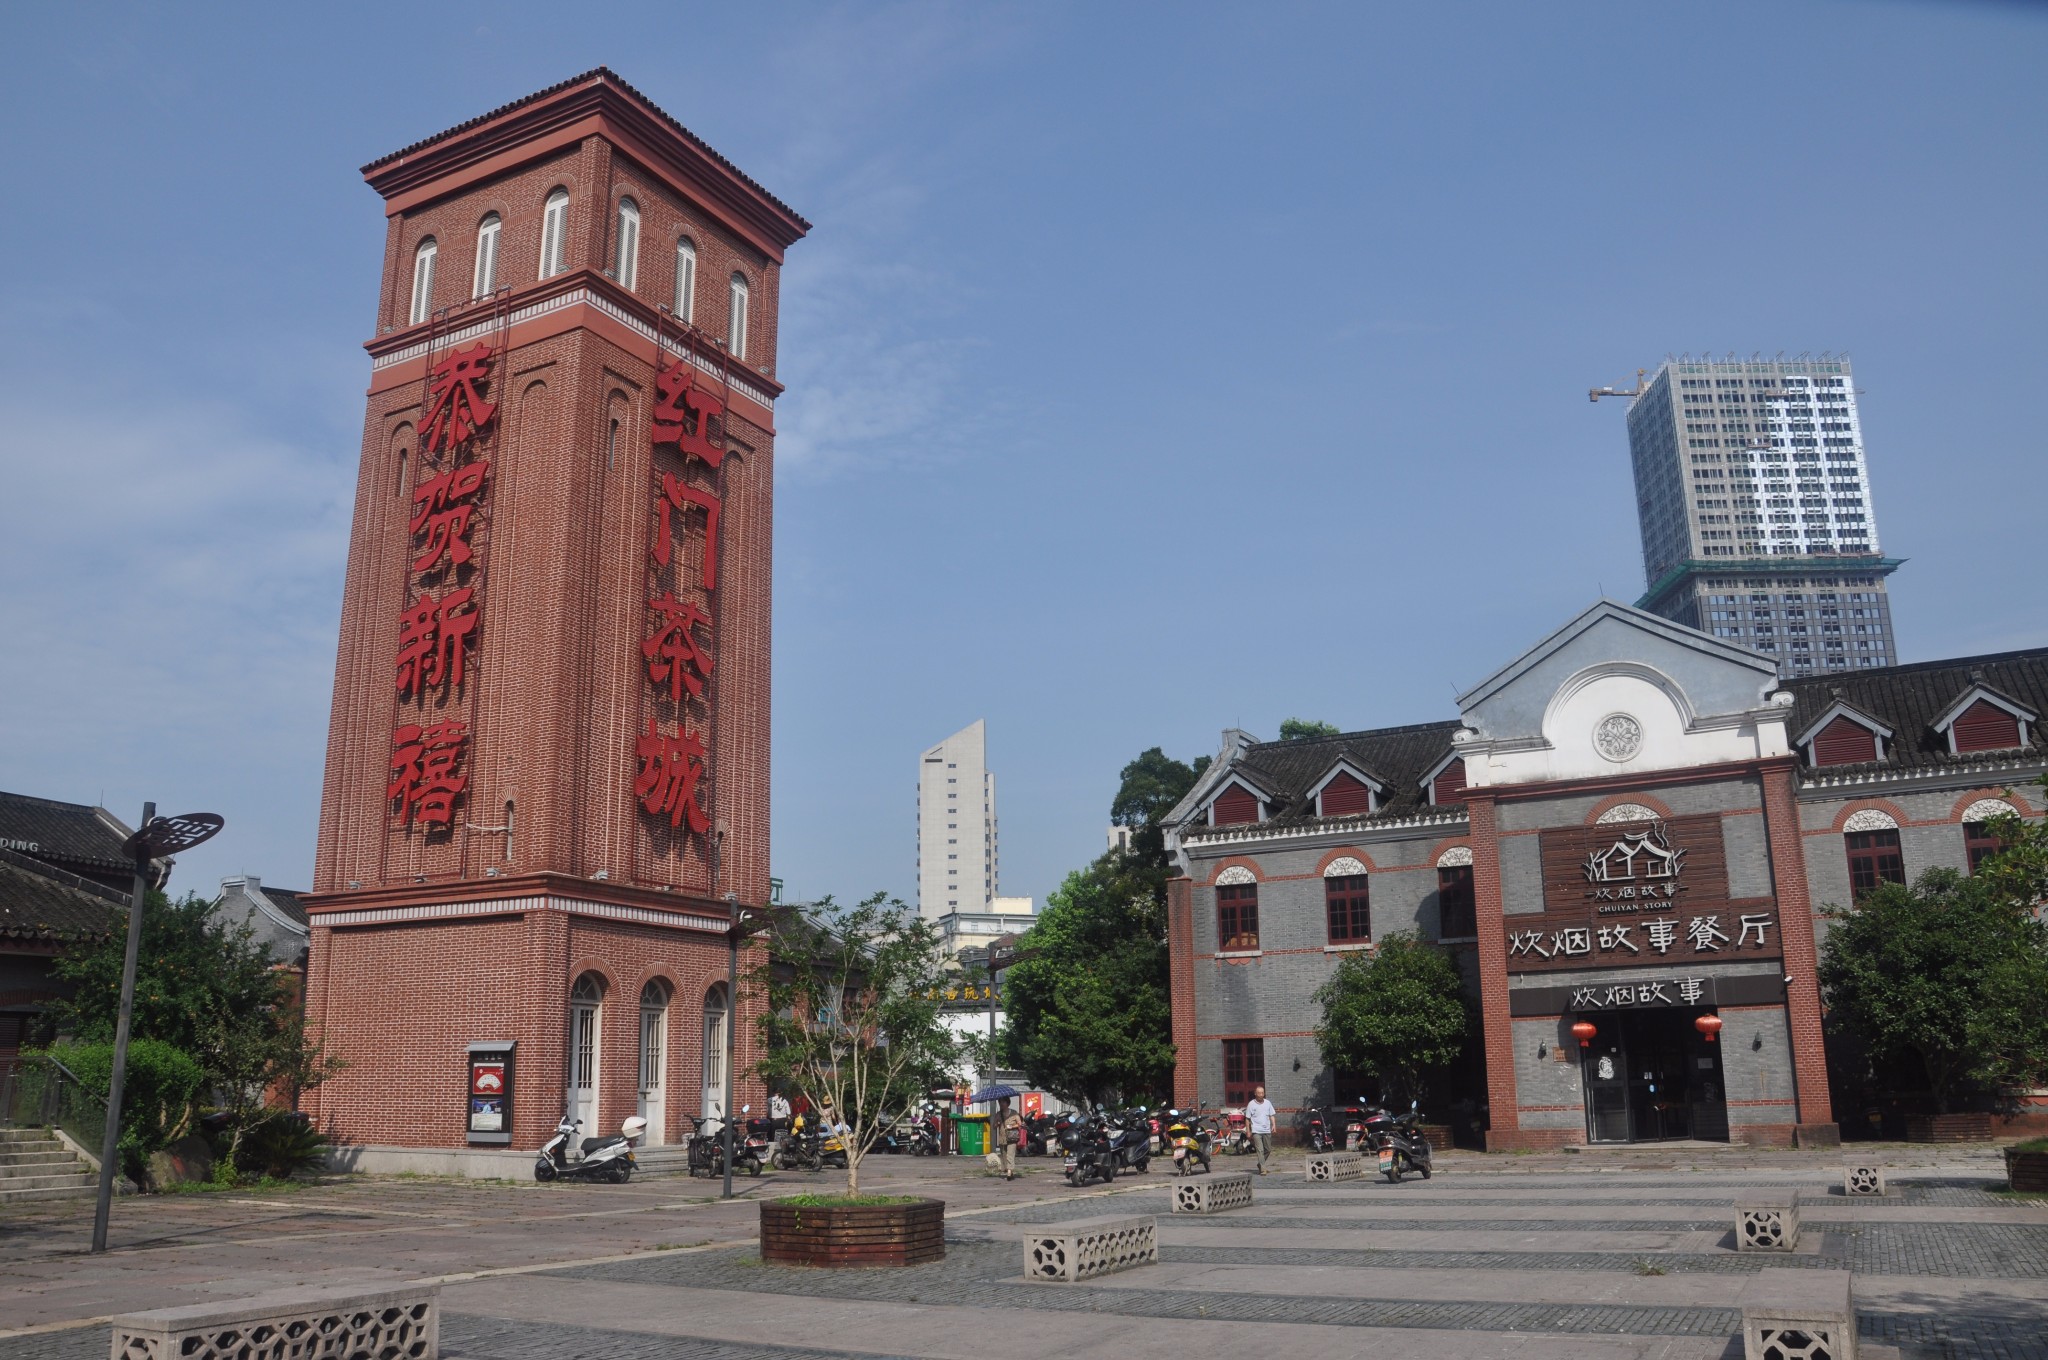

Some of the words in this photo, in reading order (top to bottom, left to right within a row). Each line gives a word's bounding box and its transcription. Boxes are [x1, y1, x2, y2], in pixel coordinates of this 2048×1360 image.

[387, 342, 497, 826] 恭贺新禧
[635, 361, 724, 833] 红门茶城
[1595, 881, 1677, 899] 炊烟故事
[1598, 903, 1639, 913] CHUIYAN
[1644, 901, 1673, 910] STORY
[1509, 913, 1773, 958] 炊烟故事餐厅
[1572, 976, 1704, 1007] 炊烟故事
